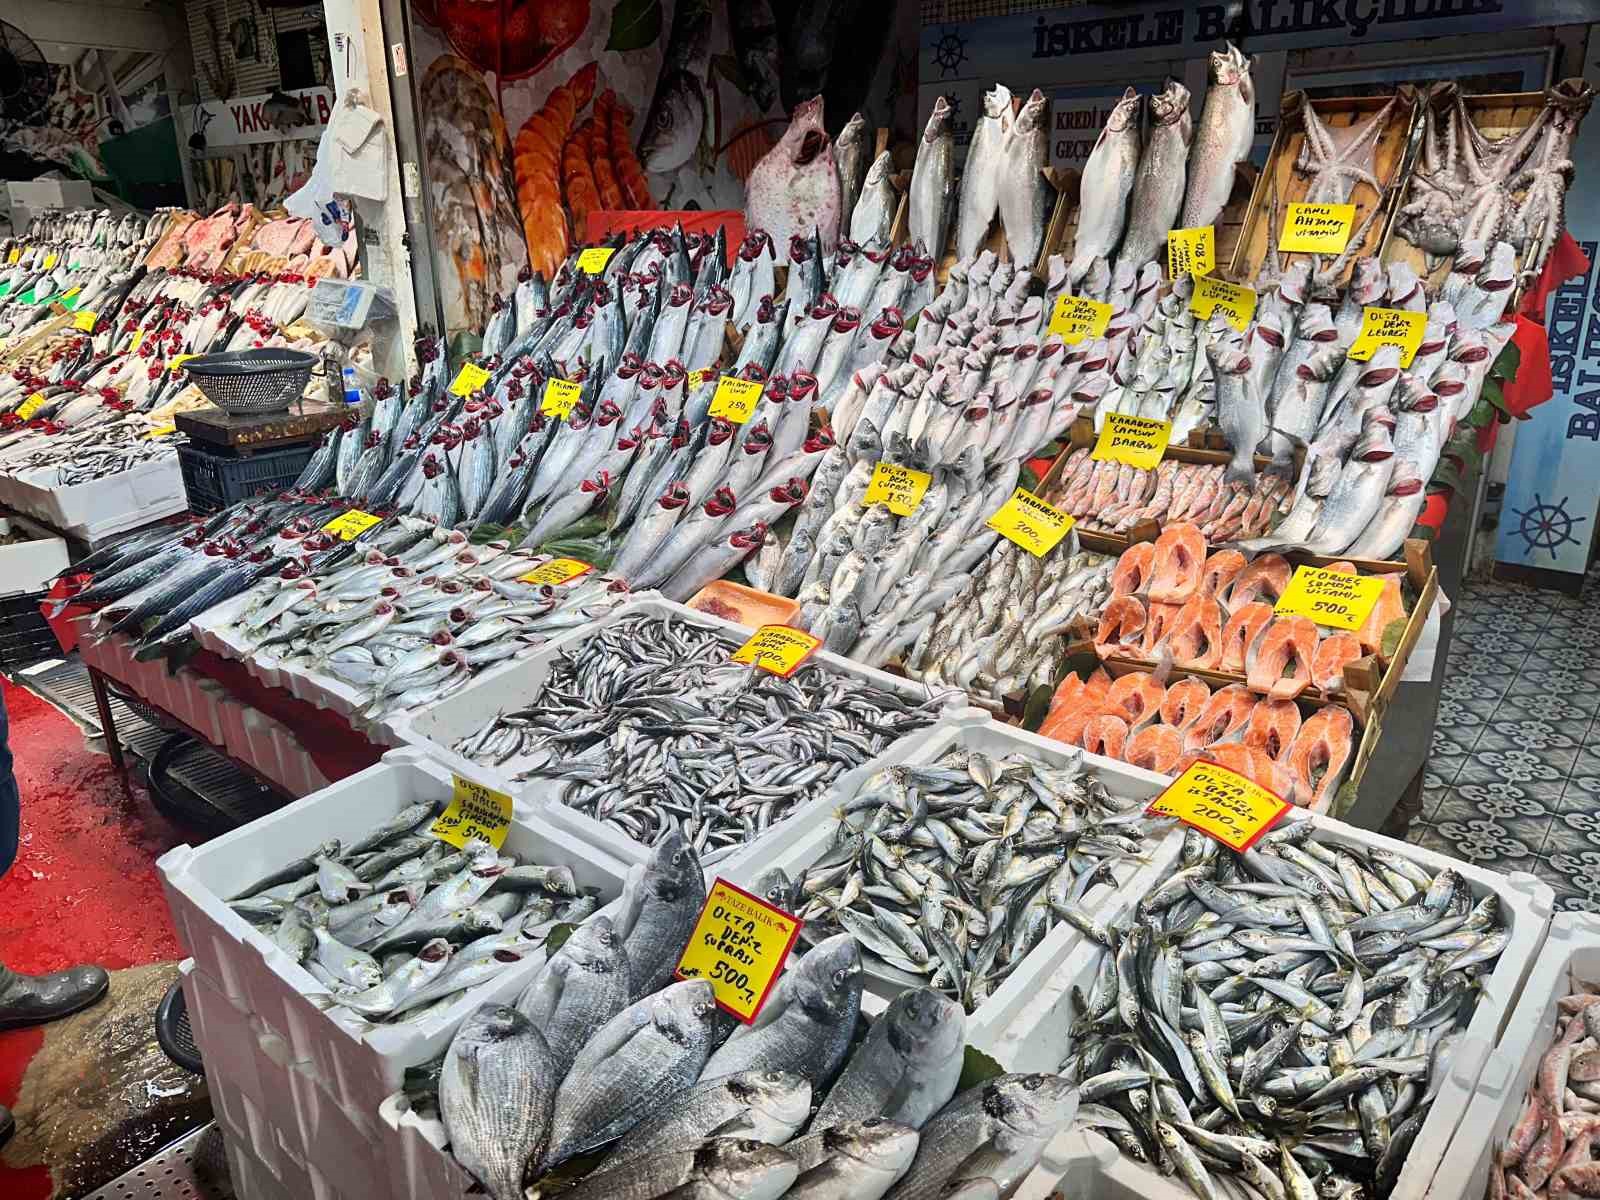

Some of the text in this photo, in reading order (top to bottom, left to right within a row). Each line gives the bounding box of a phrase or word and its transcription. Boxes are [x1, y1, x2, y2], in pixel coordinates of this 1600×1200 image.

[1032, 9, 1184, 59] İSKELE
[1056, 106, 1097, 129] KREDİ
[1370, 312, 1400, 321] OLTA
[1311, 601, 1349, 614] 500
[1194, 774, 1246, 796] OLTA
[1192, 803, 1235, 825] 200
[713, 905, 756, 934] OLTA
[726, 895, 774, 928] TAZE BALIK
[721, 926, 763, 956] DENİZ
[708, 960, 749, 990] 500
